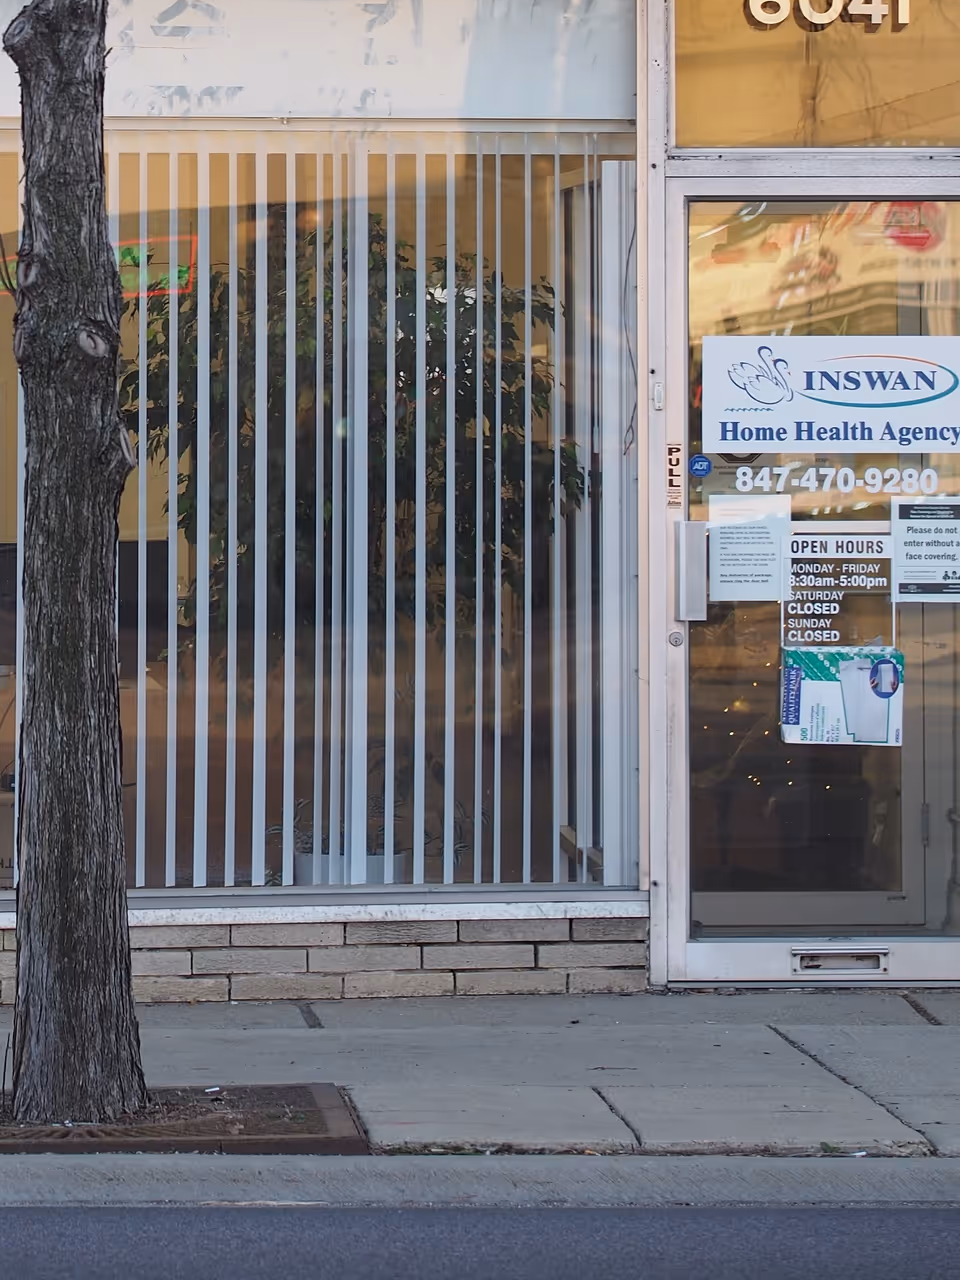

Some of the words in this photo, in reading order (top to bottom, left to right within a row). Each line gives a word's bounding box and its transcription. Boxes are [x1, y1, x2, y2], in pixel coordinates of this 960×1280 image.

[803, 370, 938, 391] INSWAN
[719, 421, 788, 442] Home
[794, 421, 873, 442] Health
[879, 421, 960, 446] Agency
[667, 447, 681, 488] PULL
[692, 461, 709, 470] ADT
[735, 466, 938, 494] 847-470-9280
[906, 526, 932, 534] Please
[791, 540, 828, 554] OPEN
[835, 540, 884, 554] HOURS
[905, 552, 922, 560] face
[923, 552, 958, 562] covering.
[791, 563, 835, 574] MONDAY
[842, 563, 881, 574] FRIDAY
[788, 591, 845, 601] SATURDAY
[787, 602, 840, 615] CLOSED
[787, 618, 833, 629] SUNDAY
[787, 630, 840, 642] CLOSED
[788, 669, 797, 688] PARK
[787, 689, 796, 724] QUALITY
[800, 727, 808, 741] 500
